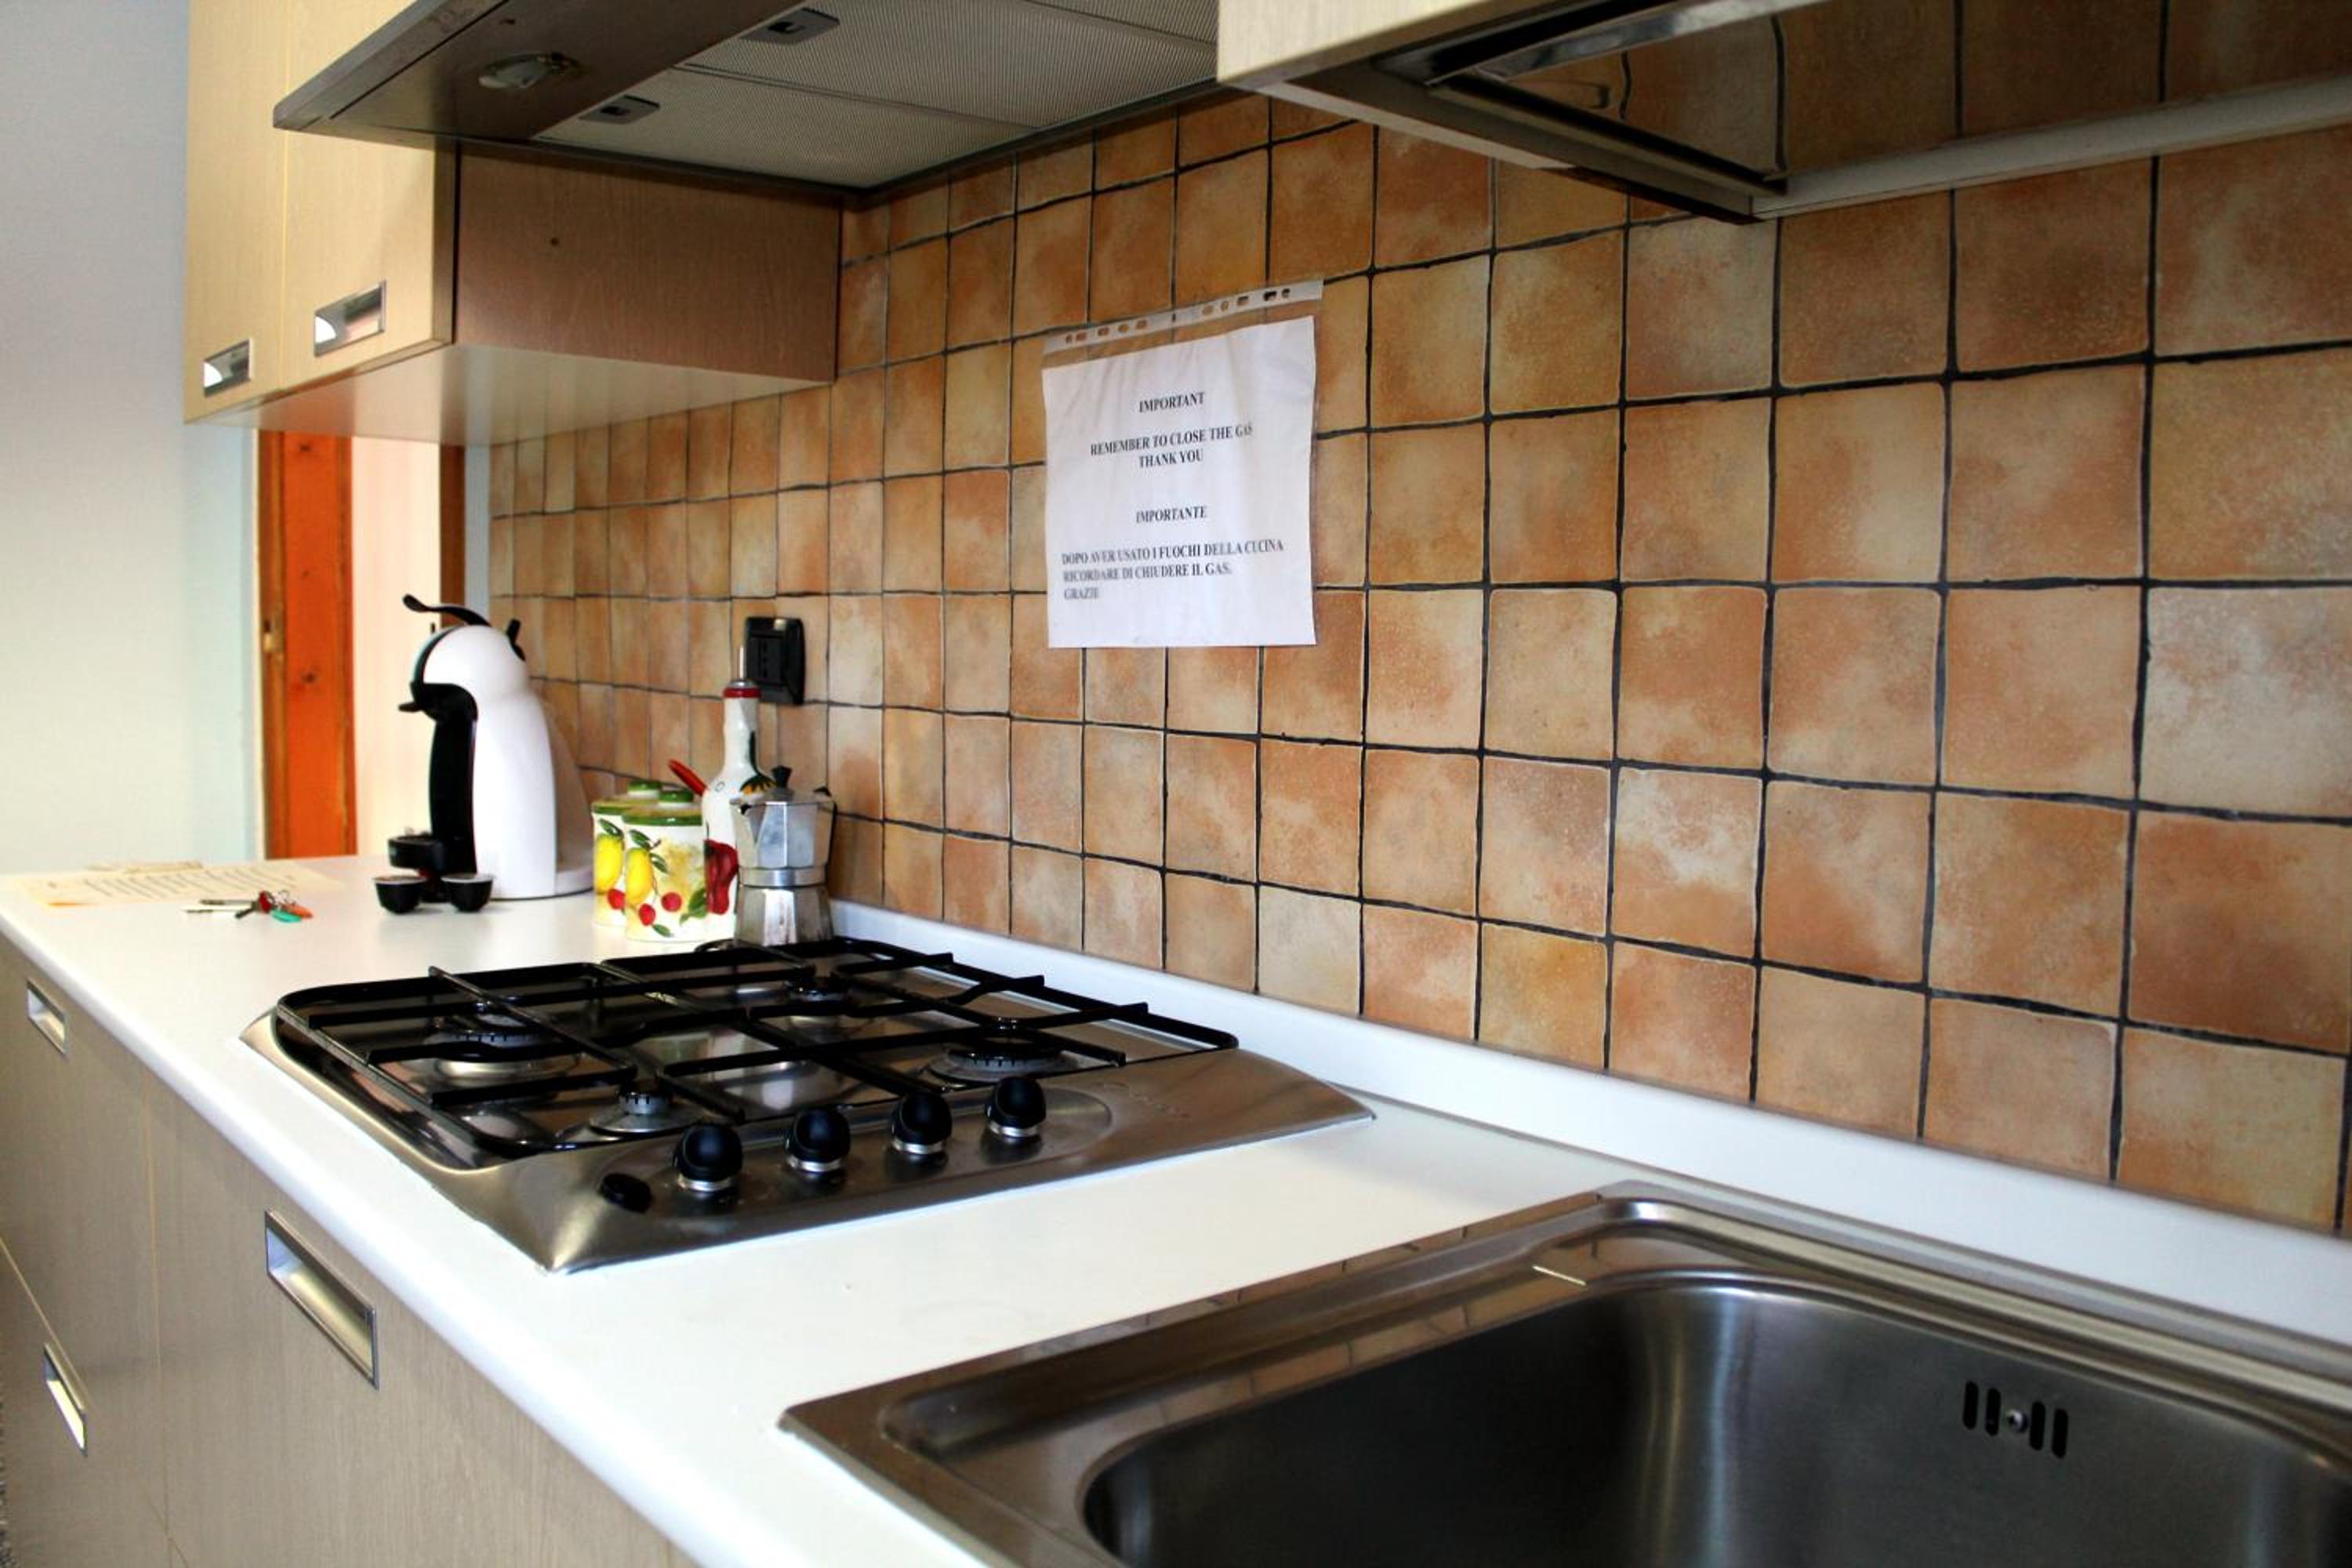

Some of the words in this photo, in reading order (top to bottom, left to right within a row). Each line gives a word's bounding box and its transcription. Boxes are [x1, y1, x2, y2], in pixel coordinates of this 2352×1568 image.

[1139, 392, 1205, 412] IMPORTANT
[1091, 436, 1150, 456] REMEMBER
[1152, 434, 1167, 448] TO
[1170, 429, 1206, 445] CLOSE
[1209, 426, 1233, 441] THE
[1139, 451, 1177, 468] THANK
[1178, 448, 1203, 464] YOU
[1135, 506, 1207, 524] IMPORTANTE
[1091, 550, 1115, 564] AVER
[1117, 547, 1150, 562] USATO
[1159, 543, 1201, 559] FUOCHI
[1203, 542, 1243, 556] DELLA
[1244, 538, 1284, 554] CUCINA
[1122, 566, 1134, 580] DI
[1134, 564, 1189, 579] CHIUDERE
[1191, 563, 1203, 577] IL
